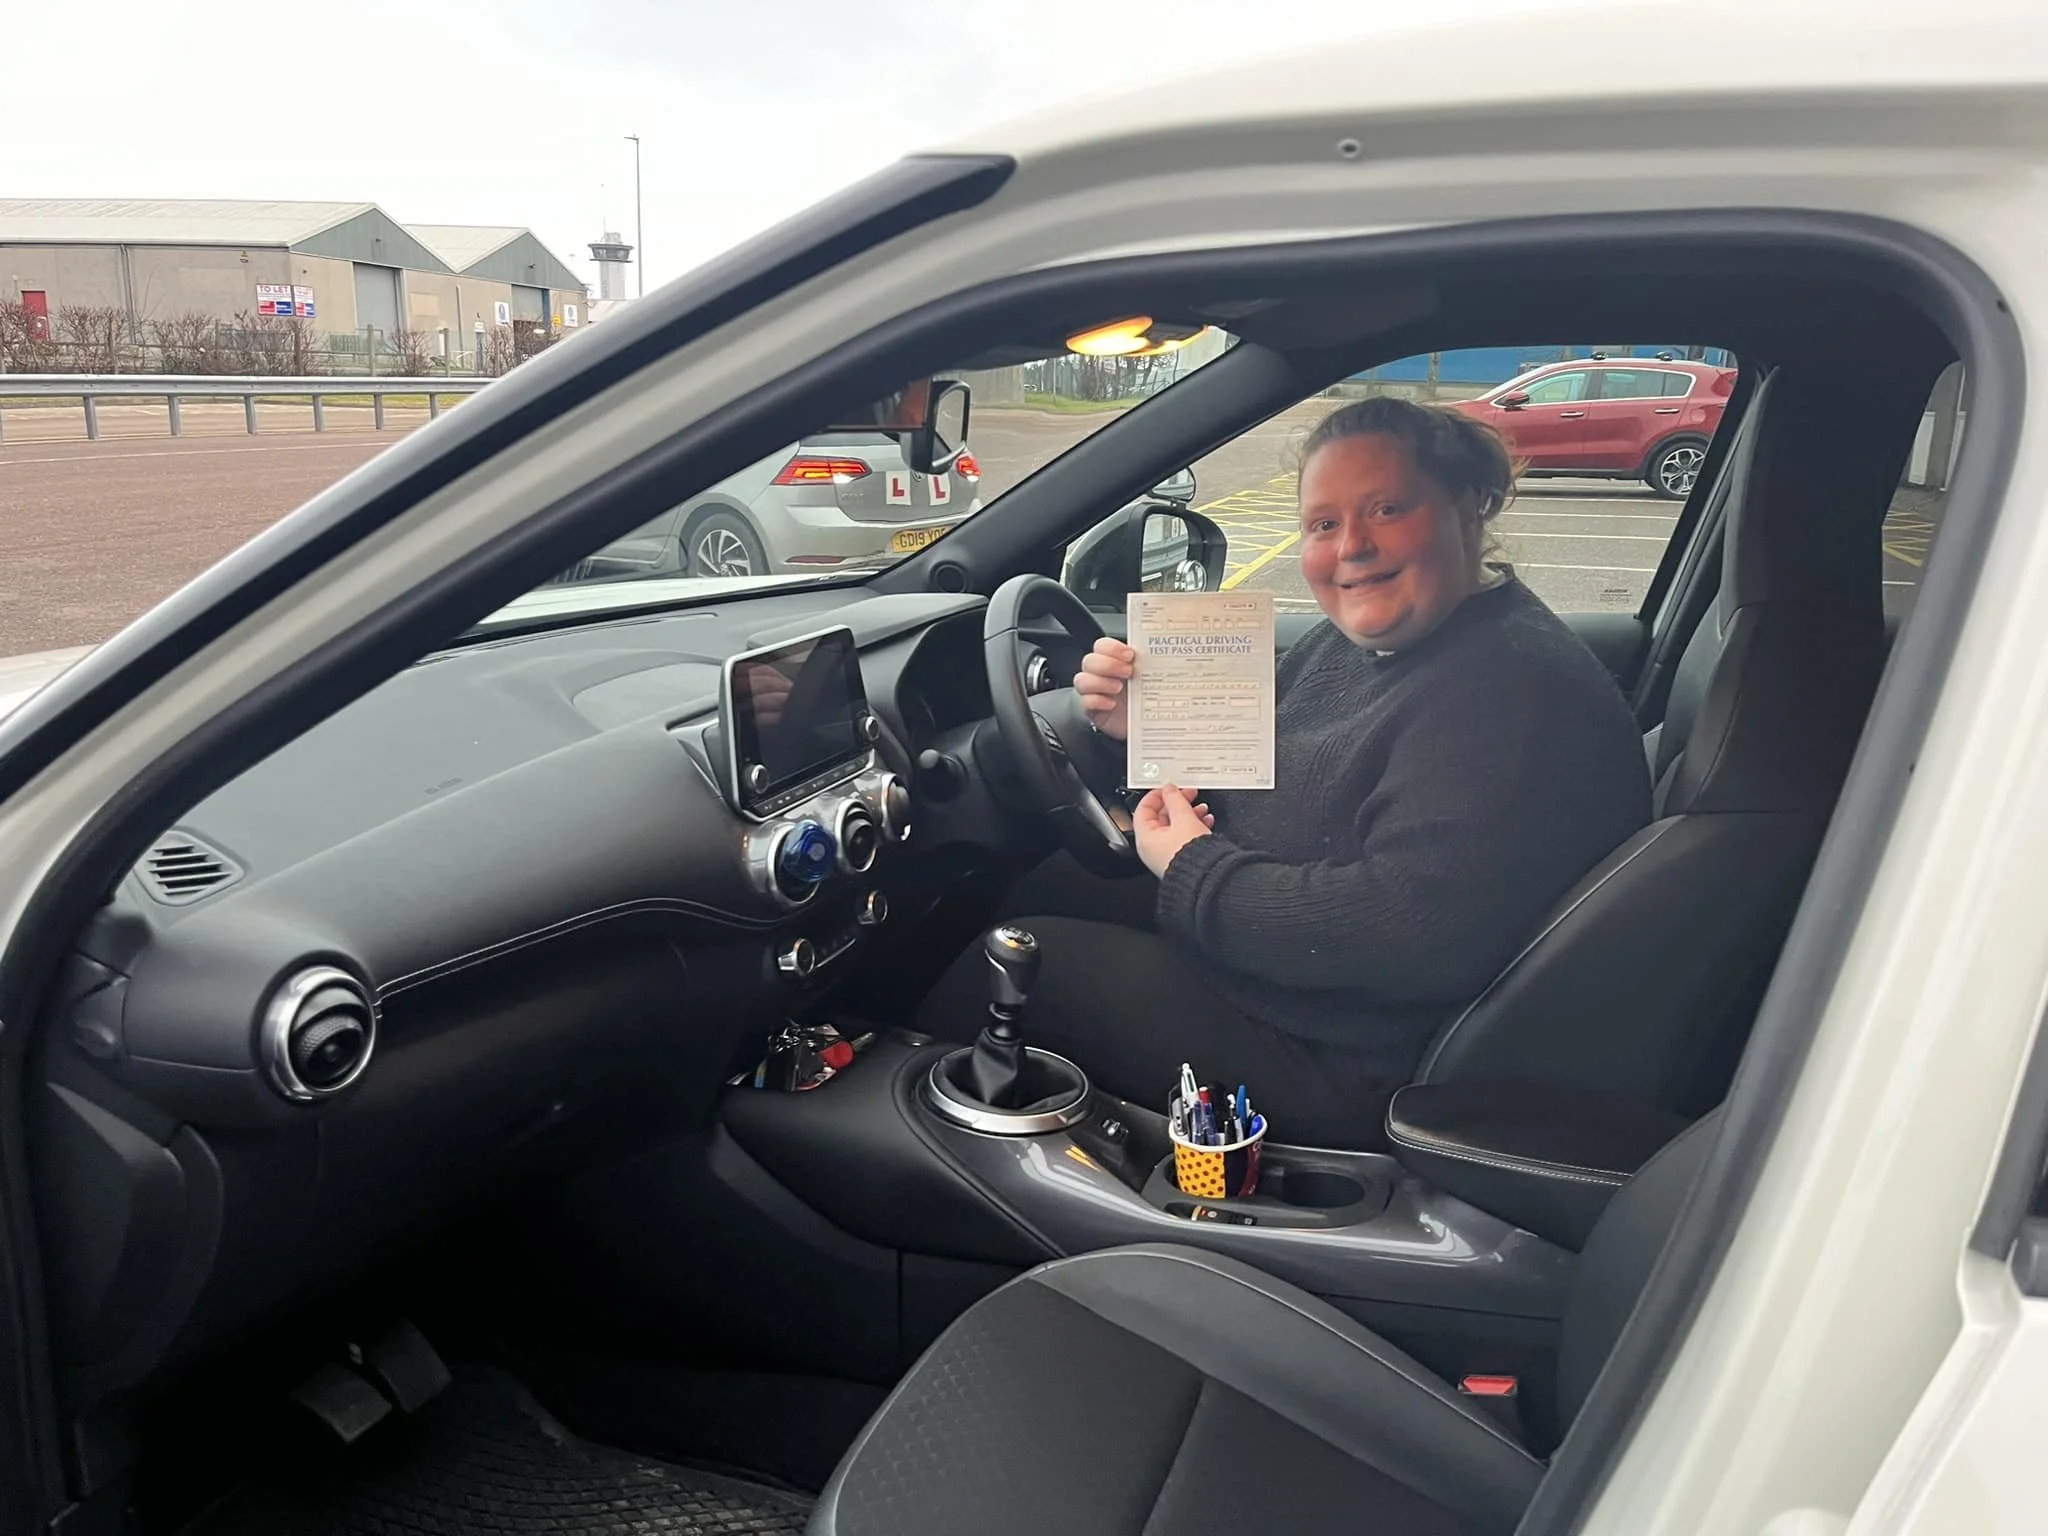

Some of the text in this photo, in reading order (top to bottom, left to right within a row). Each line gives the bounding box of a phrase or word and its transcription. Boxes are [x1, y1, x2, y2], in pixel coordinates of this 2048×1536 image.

[892, 478, 904, 496] L
[934, 476, 945, 498] L
[899, 532, 925, 548] GD19
[1149, 635, 1252, 645] PRACTICAL DRIVING
[1149, 645, 1251, 655] TEST PASS CERTIFICATE
